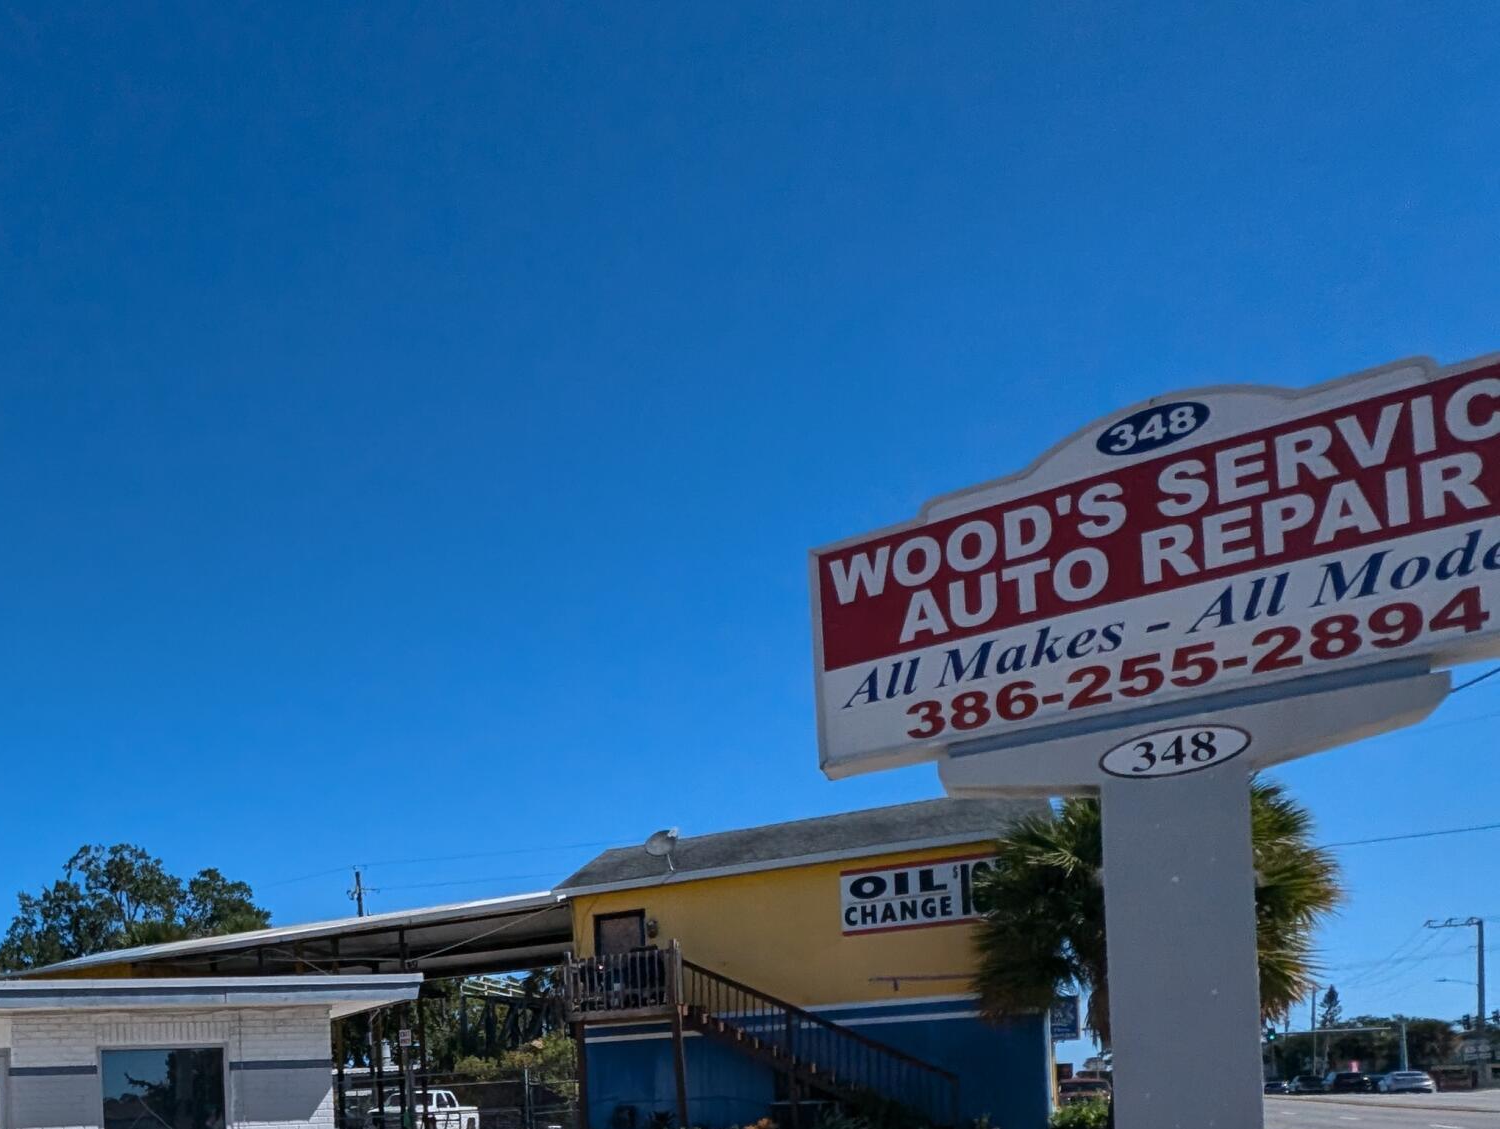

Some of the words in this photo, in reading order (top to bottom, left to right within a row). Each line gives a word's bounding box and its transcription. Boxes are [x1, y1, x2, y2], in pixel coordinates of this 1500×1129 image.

[1110, 406, 1197, 452] 348
[829, 483, 1127, 605] WOOD'S
[1157, 378, 1500, 517] SERVIC
[899, 547, 1109, 644] AUTO
[1141, 451, 1491, 584] REPAIR
[842, 657, 921, 709] All
[935, 621, 1125, 689] Makes
[1185, 571, 1290, 634] All
[906, 586, 1490, 738] 386-255-2894
[1132, 731, 1217, 772] 348
[844, 896, 953, 926] CHANGE
[850, 869, 947, 899] OIL
